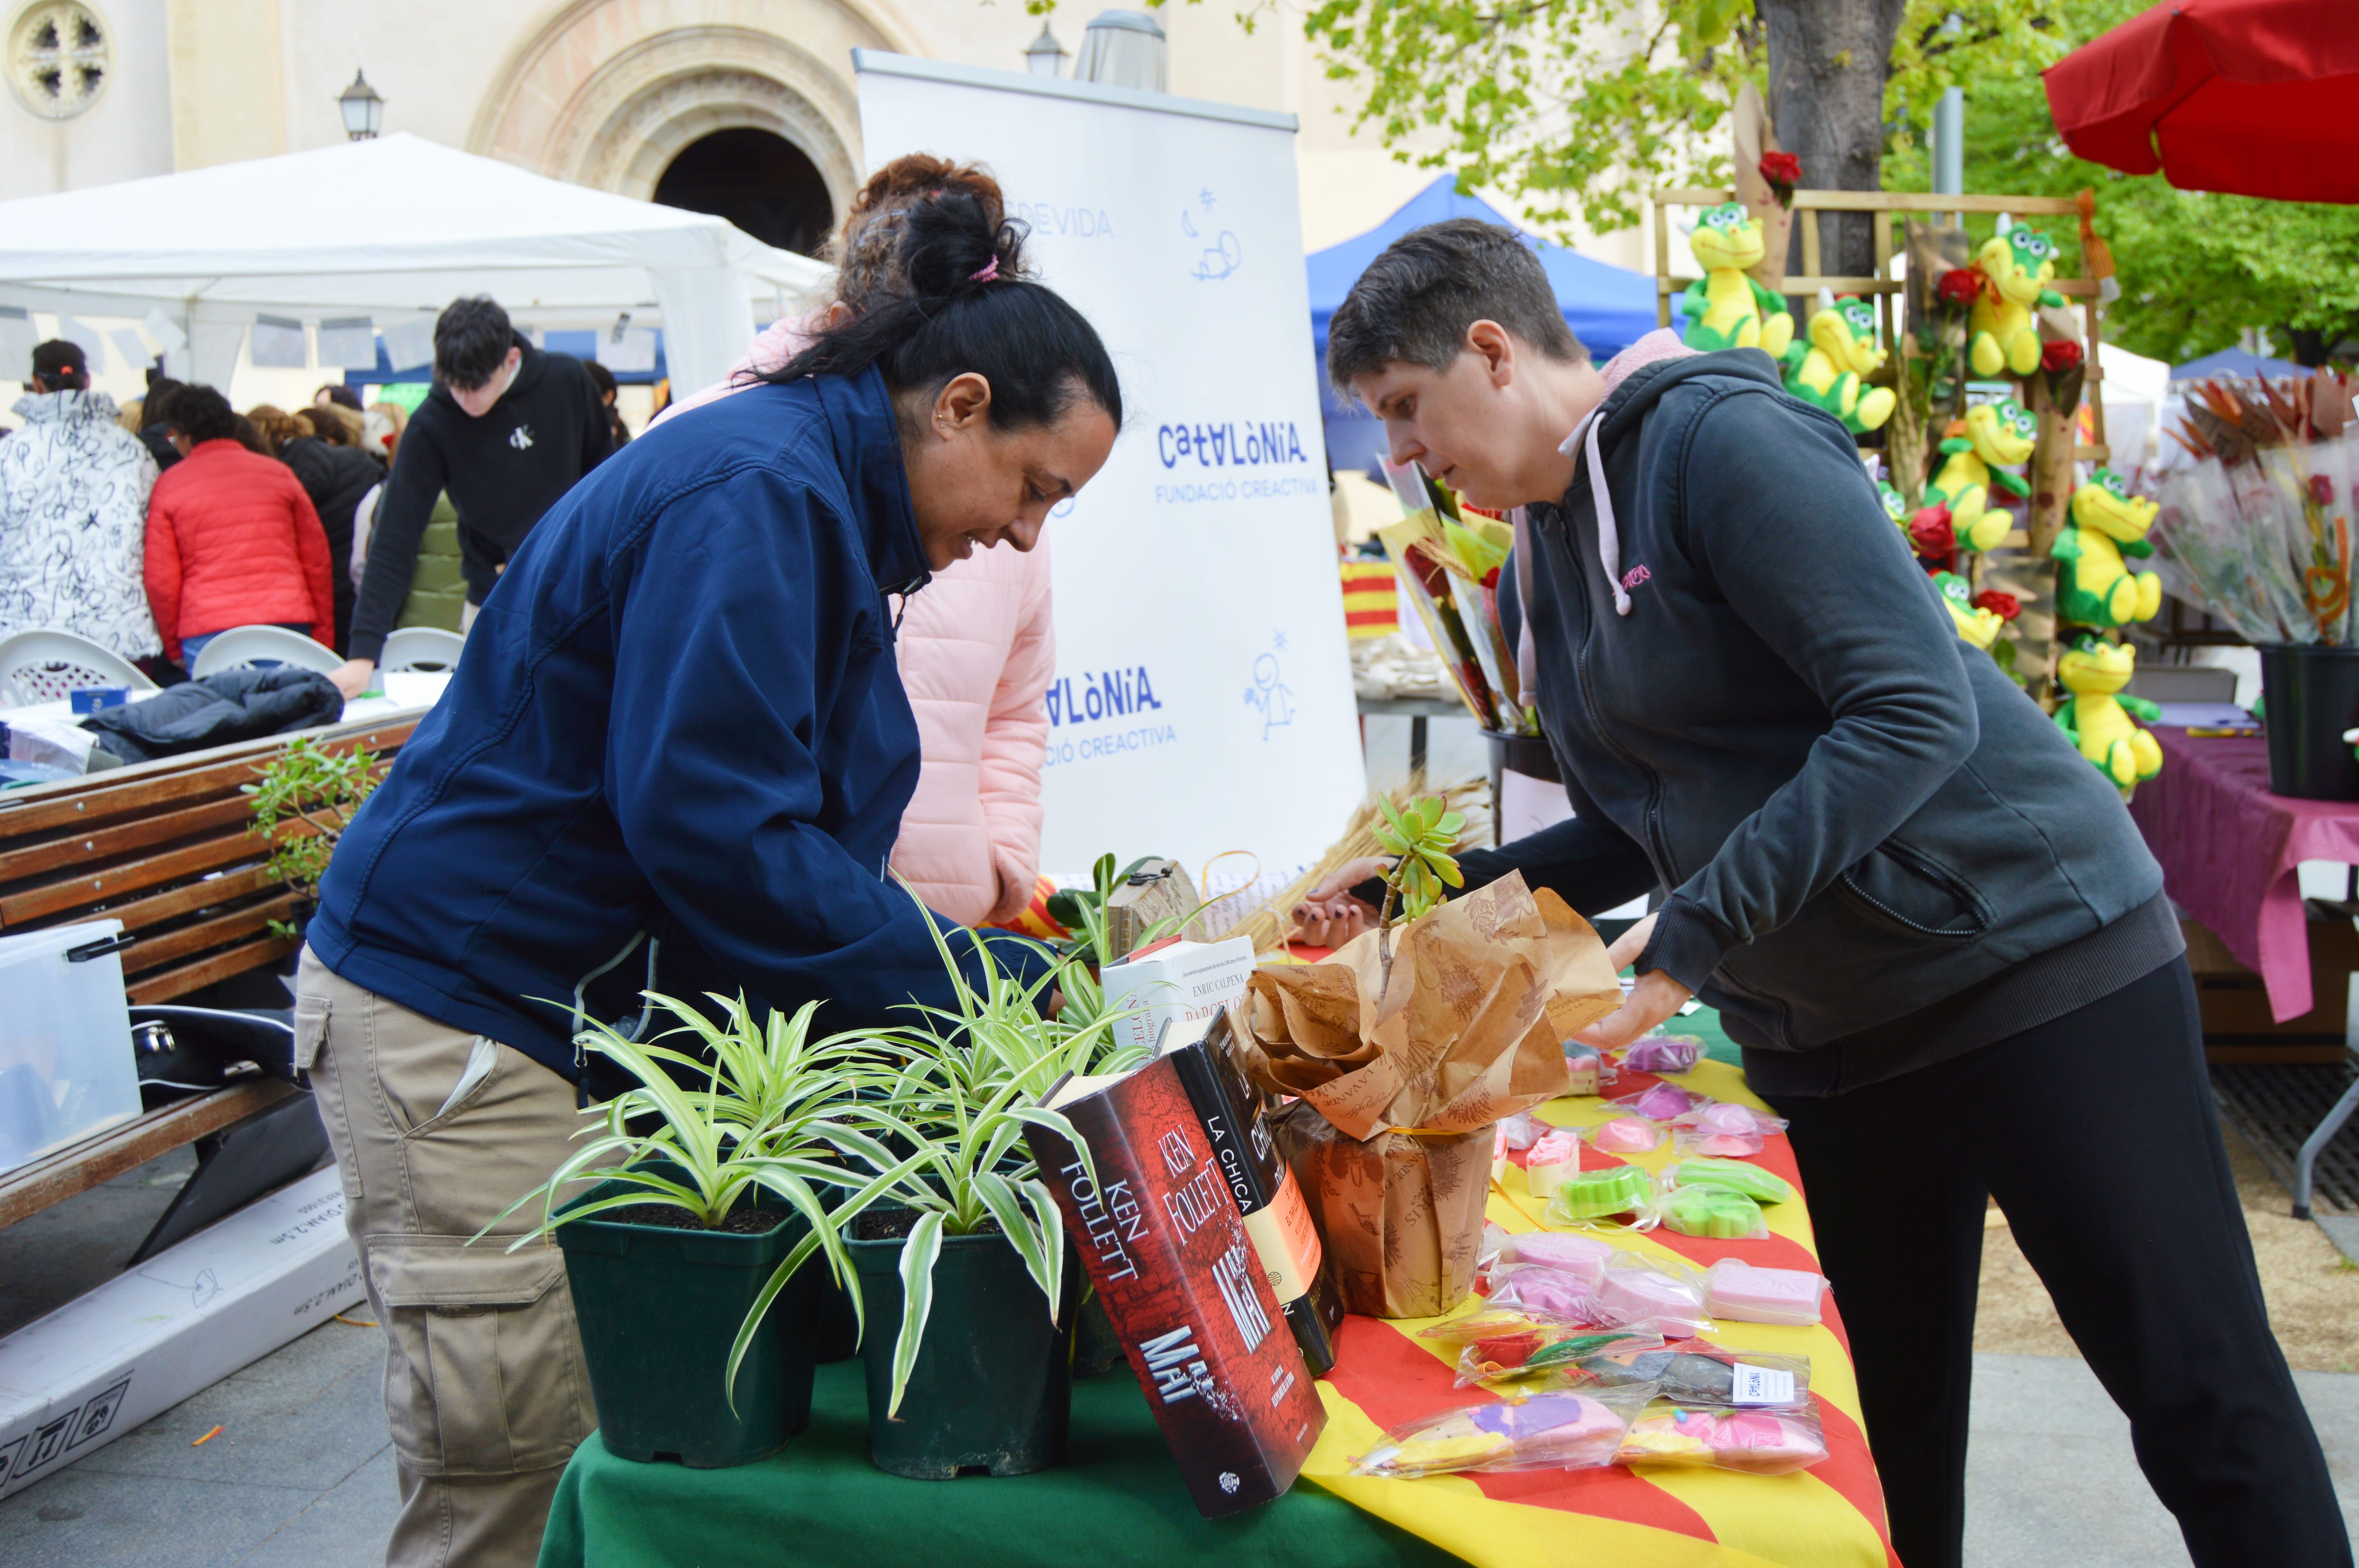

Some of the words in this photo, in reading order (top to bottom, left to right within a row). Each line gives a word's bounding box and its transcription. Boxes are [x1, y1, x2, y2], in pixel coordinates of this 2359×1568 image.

[1157, 477, 1236, 503] FUNDACIÓ
[1241, 477, 1318, 499] CREACTIVA
[1080, 725, 1177, 759] CREACTIVA
[1192, 981, 1214, 998] ENRIC
[1215, 973, 1244, 991] CALPENA
[1239, 1073, 1251, 1099] LA
[1323, 1069, 1374, 1107] LAVANDE
[1158, 1124, 1196, 1179] KEN
[1251, 1112, 1272, 1161] CHIC
[1208, 1116, 1225, 1142] LA
[1221, 1149, 1252, 1212] CHICA
[1393, 1151, 1425, 1182] VANDE
[1060, 1160, 1138, 1279] FOLLETT
[1104, 1178, 1149, 1242] KEN
[1162, 1157, 1230, 1246] FOLLETT
[1405, 1195, 1432, 1226] RIS
